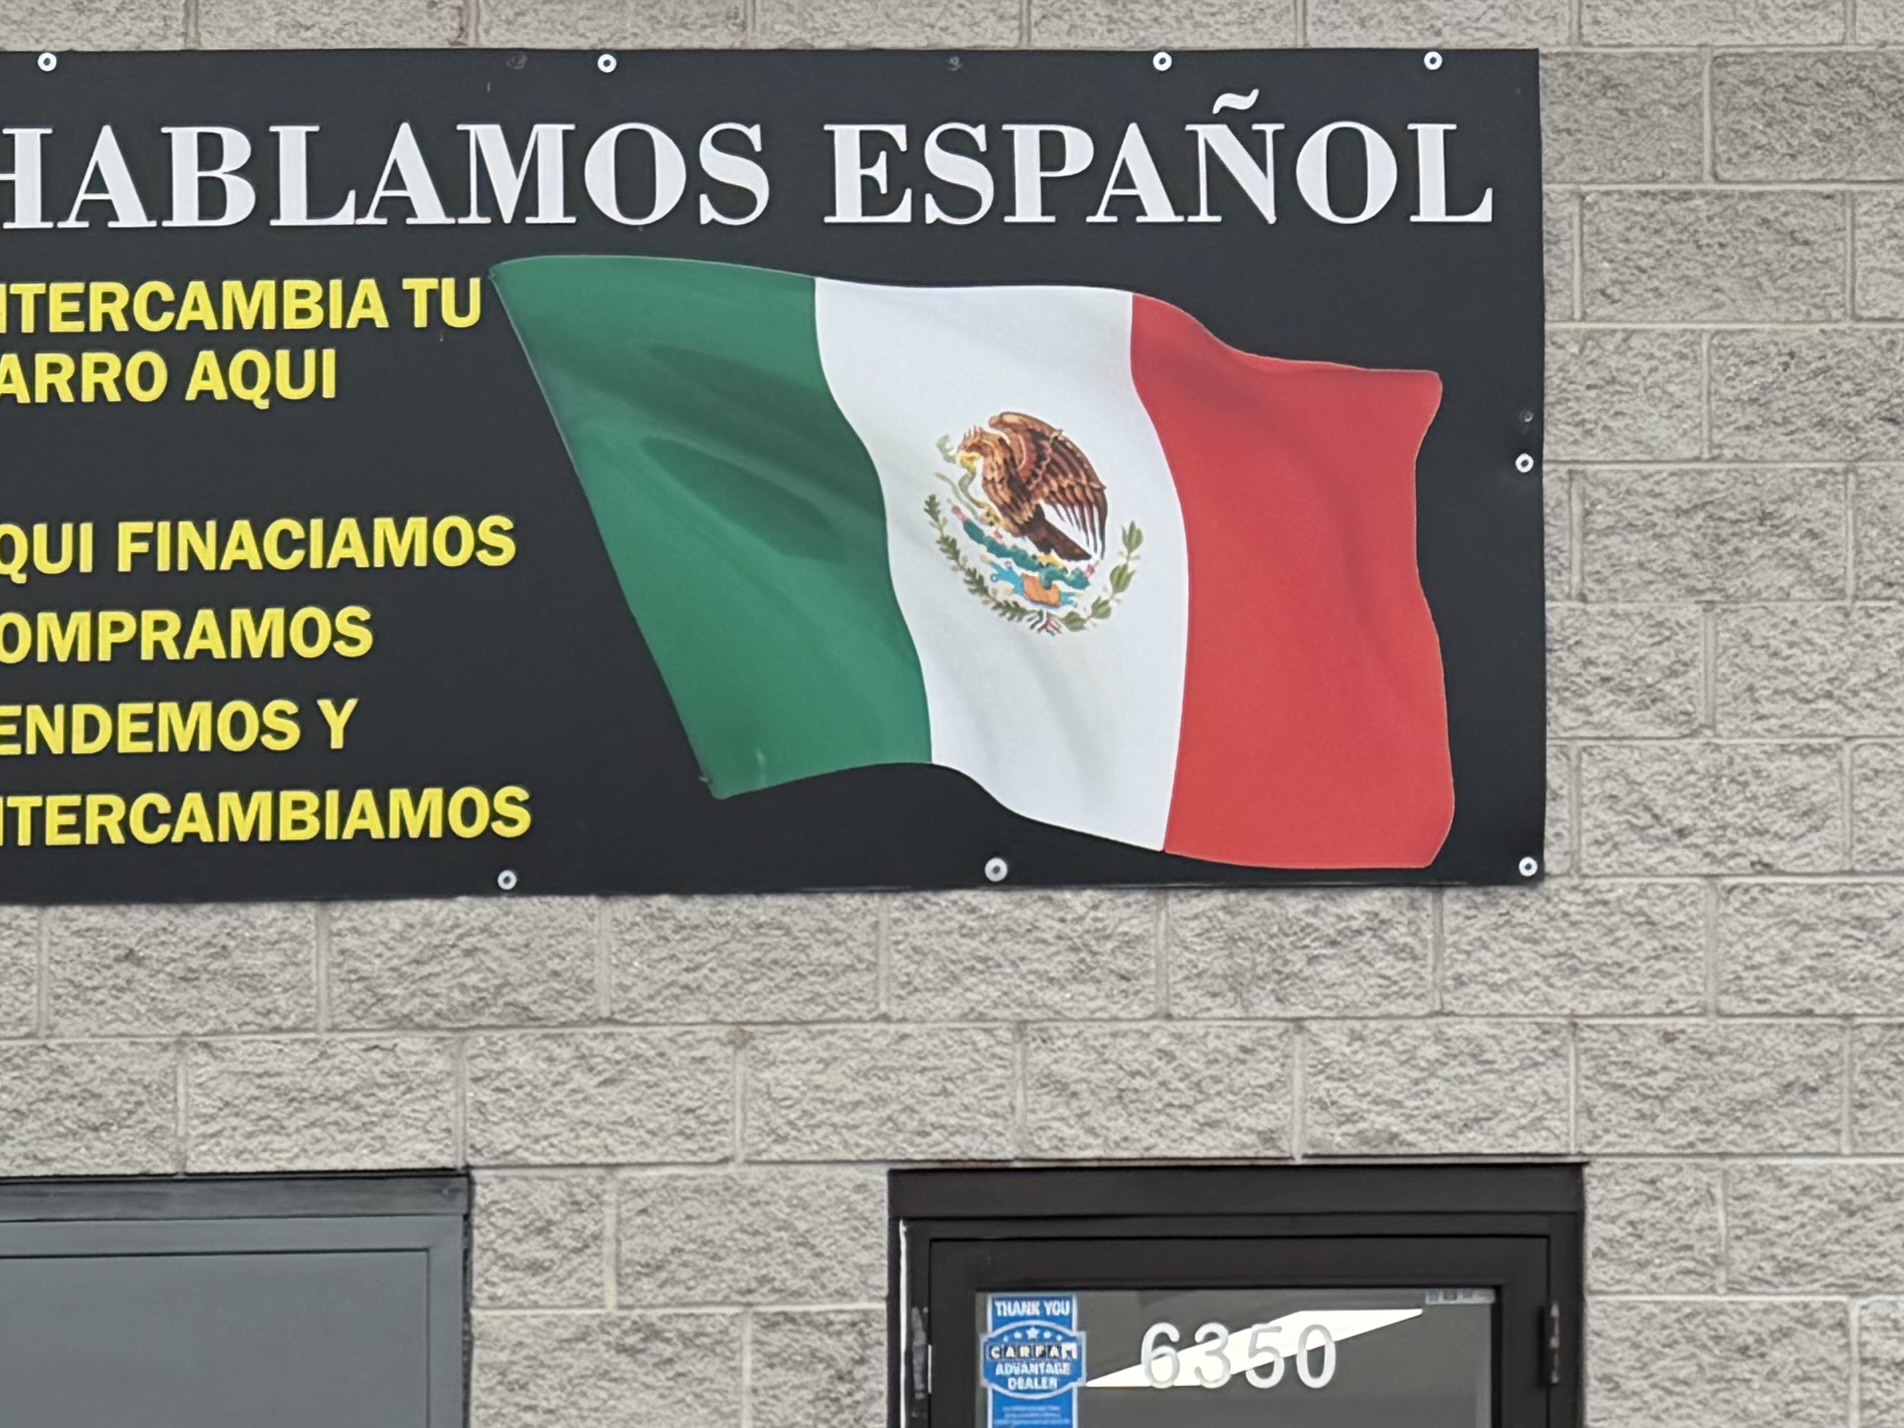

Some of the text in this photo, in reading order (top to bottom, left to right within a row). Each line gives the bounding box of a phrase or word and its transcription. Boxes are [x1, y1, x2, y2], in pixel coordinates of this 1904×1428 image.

[823, 88, 1492, 225] ESPAÑOL
[402, 276, 482, 329] TU
[184, 347, 338, 410] AQUI
[117, 515, 517, 573] FINACIAMOS
[316, 698, 359, 750] Y
[994, 1299, 1071, 1317] THANK YOU
[995, 1361, 1072, 1376] ADVANTAGE
[1141, 1321, 1337, 1390] 6350
[1007, 1376, 1058, 1391] DEALER
